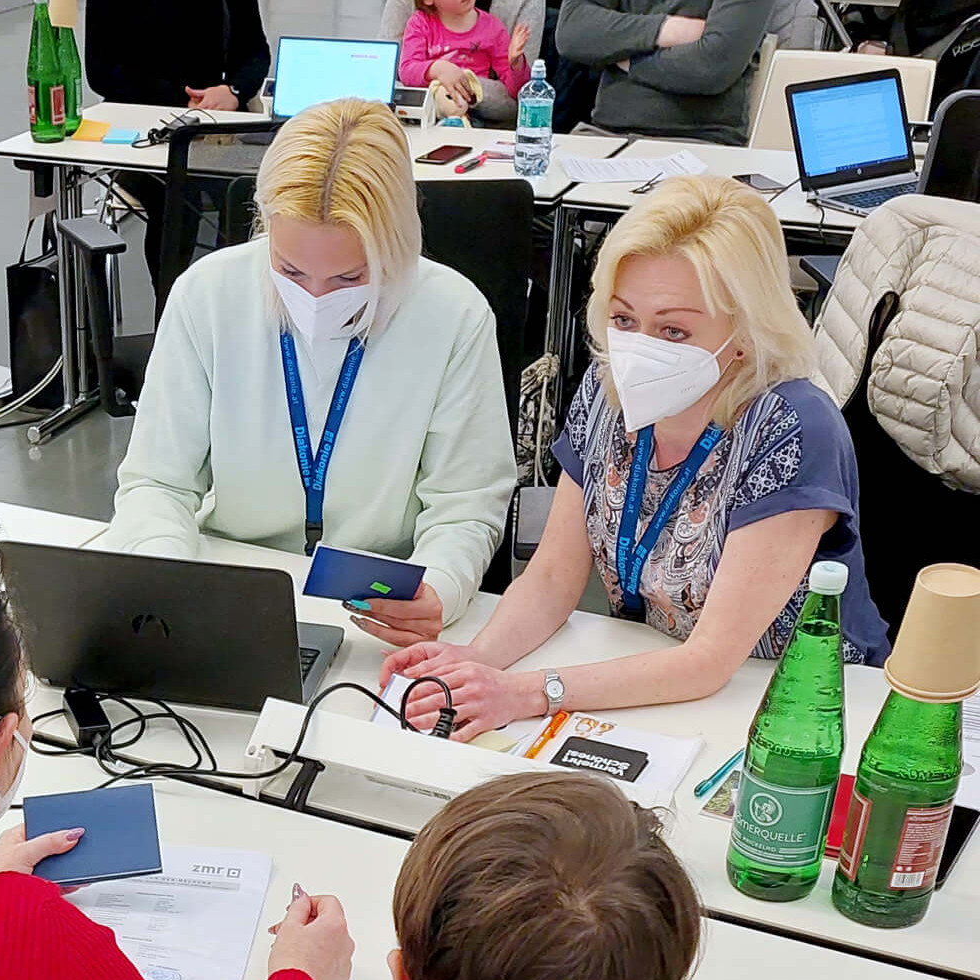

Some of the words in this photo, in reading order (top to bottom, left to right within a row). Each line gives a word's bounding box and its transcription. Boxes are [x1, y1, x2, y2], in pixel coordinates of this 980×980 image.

[283, 336, 299, 405] www.diakonie.at
[336, 345, 360, 411] www.diakonie
[294, 426, 310, 477] Diakonie
[699, 424, 722, 451] Dia
[313, 443, 332, 491] Diakonie
[628, 439, 645, 514] www.diakonie.at
[655, 467, 692, 530] www.diakonie.at
[626, 555, 642, 596] Diakonie
[561, 756, 624, 777] Vermehrt
[192, 863, 224, 875] zmr
